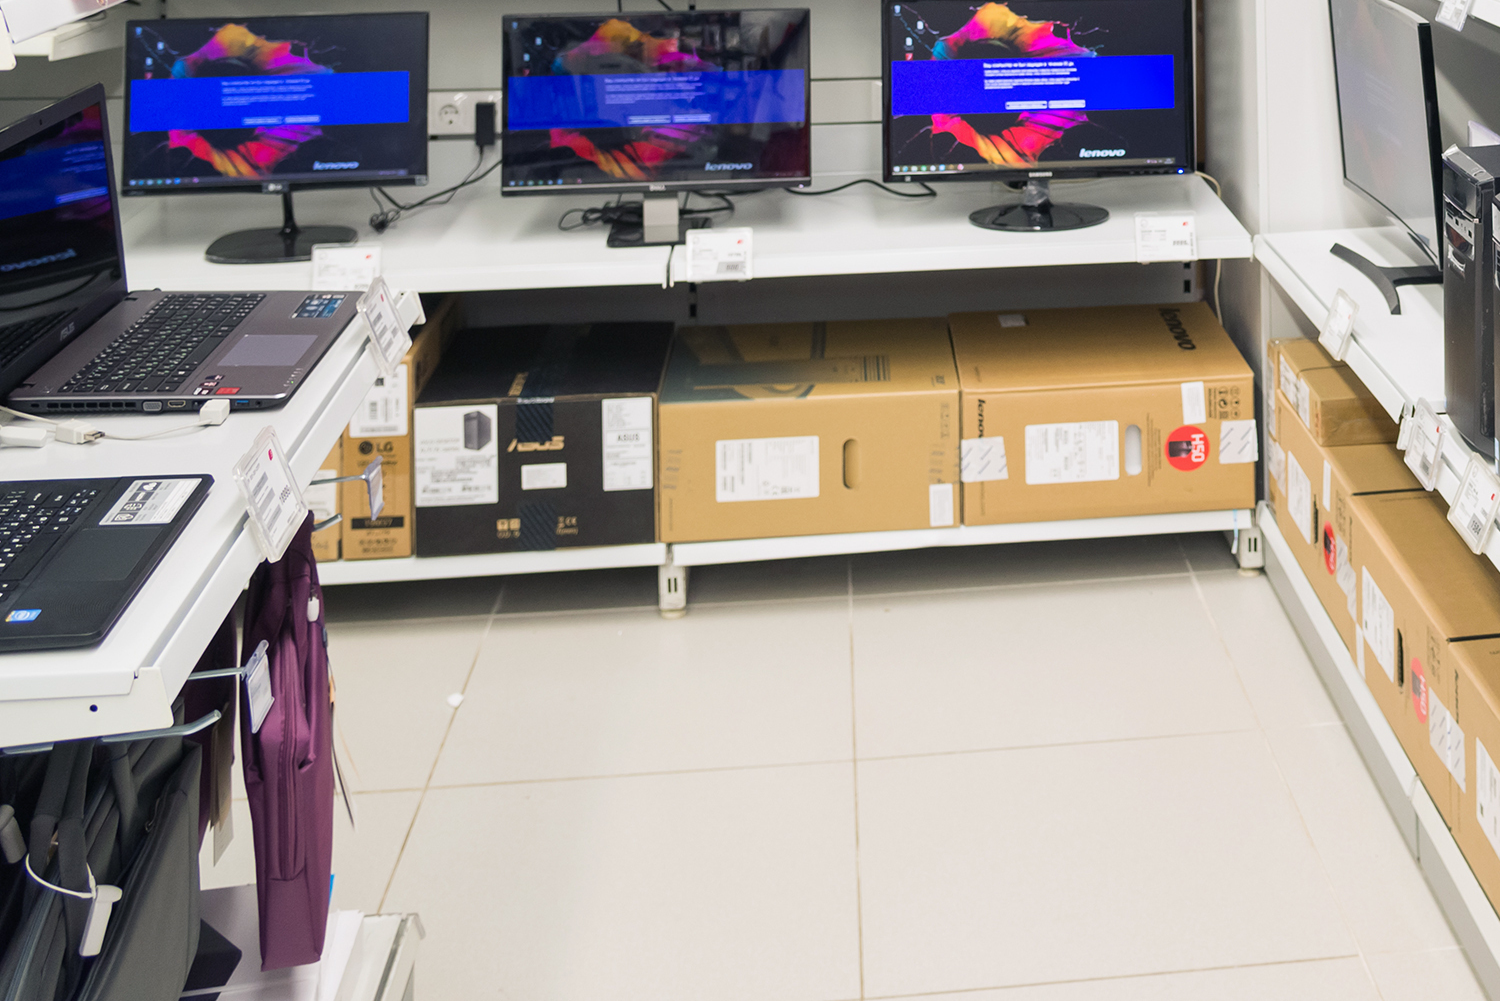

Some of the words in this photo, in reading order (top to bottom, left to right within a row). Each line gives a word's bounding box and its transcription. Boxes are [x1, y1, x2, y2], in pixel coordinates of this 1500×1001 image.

[1079, 148, 1126, 158] lenovo
[312, 161, 360, 171] lenovo
[704, 162, 753, 172] lenovo
[1158, 307, 1197, 352] lenovo
[977, 398, 986, 438] lenov
[617, 433, 640, 442] ASUS
[1190, 432, 1206, 464] H50
